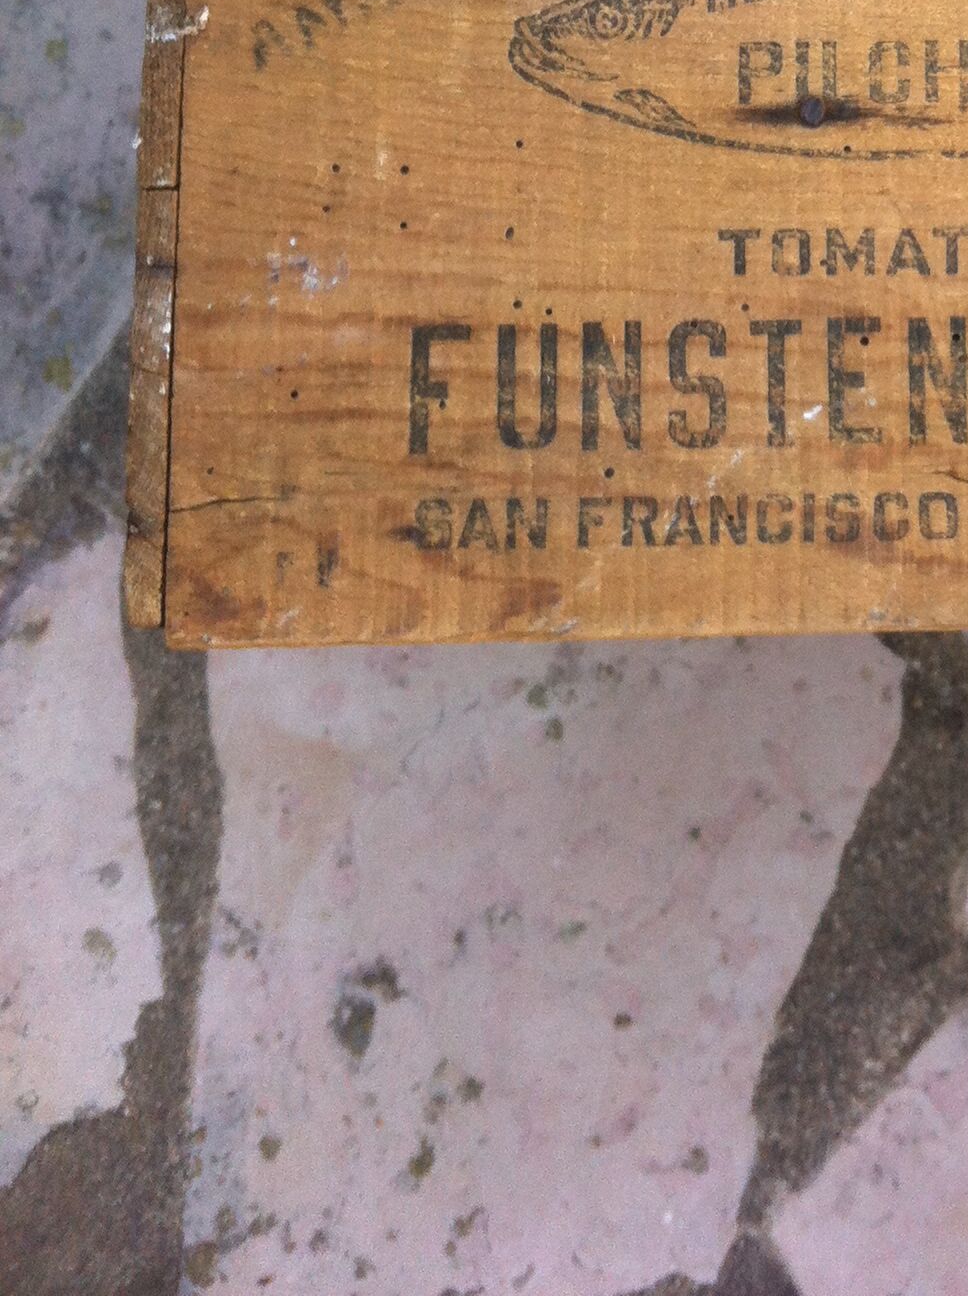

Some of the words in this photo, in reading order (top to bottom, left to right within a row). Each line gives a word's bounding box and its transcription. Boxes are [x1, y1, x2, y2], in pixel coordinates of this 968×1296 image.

[408, 315, 968, 455] FUNSTEN
[414, 495, 549, 550] SAN
[577, 490, 960, 548] FRANCISCO
